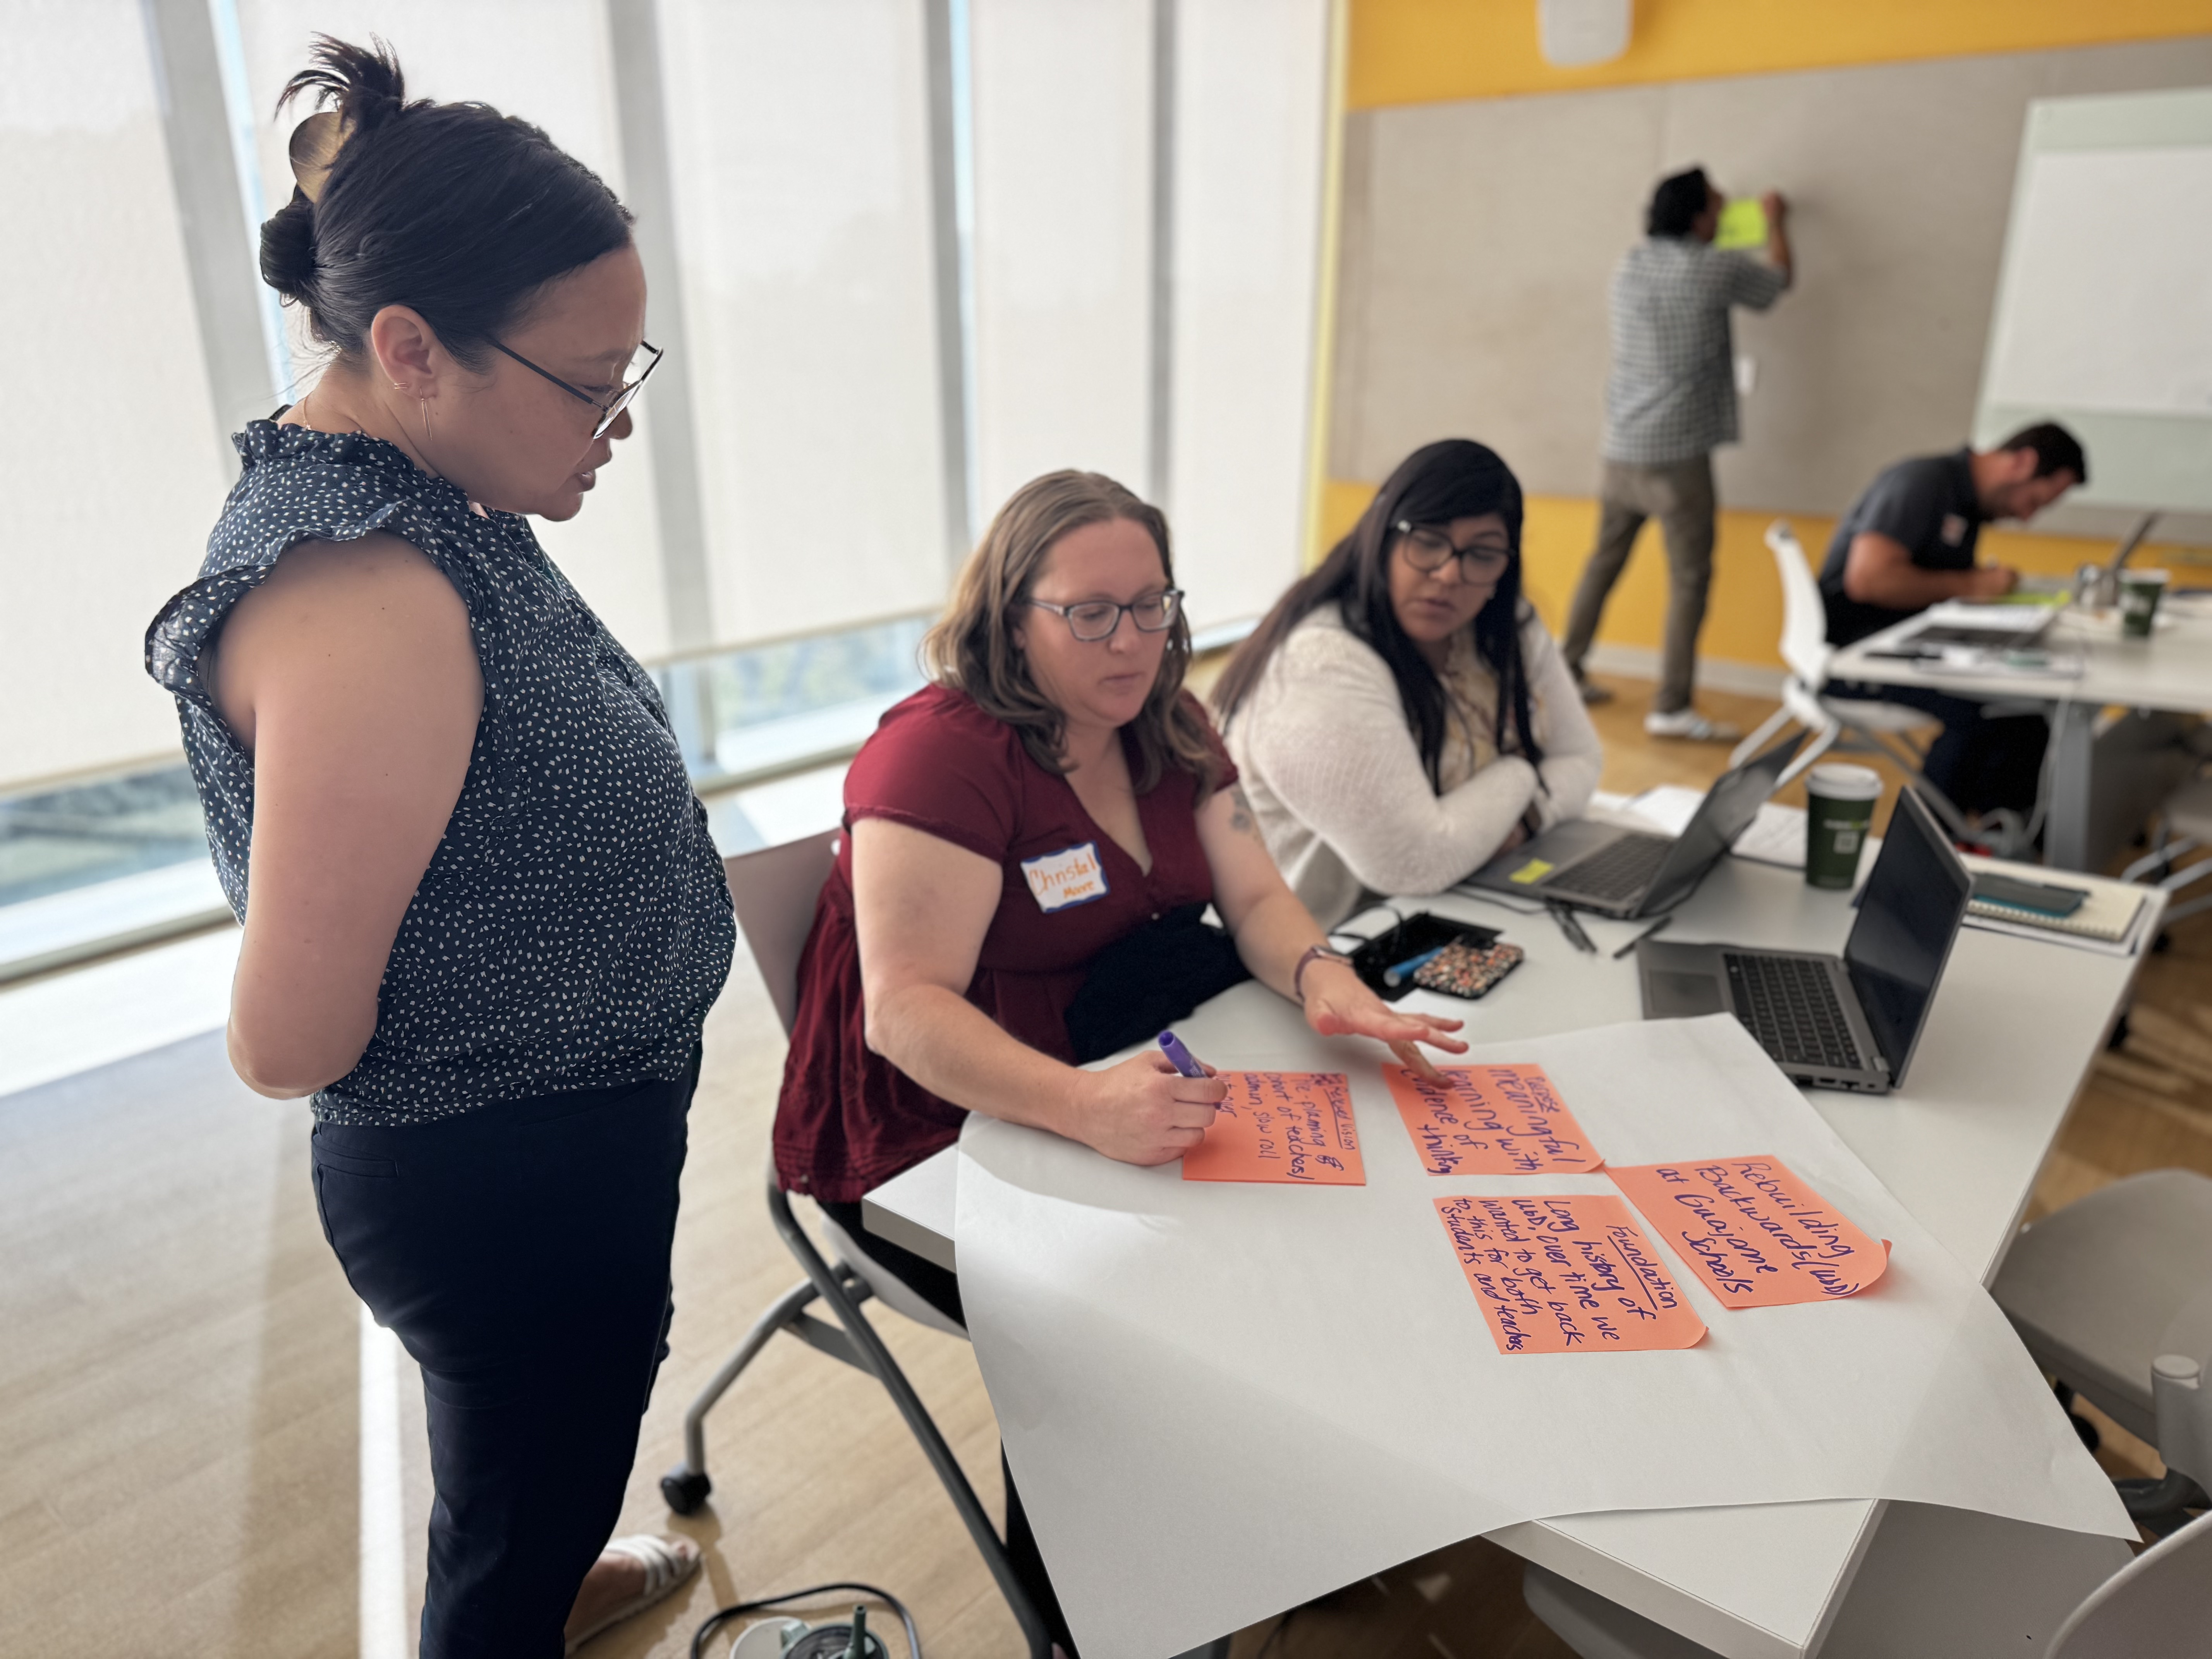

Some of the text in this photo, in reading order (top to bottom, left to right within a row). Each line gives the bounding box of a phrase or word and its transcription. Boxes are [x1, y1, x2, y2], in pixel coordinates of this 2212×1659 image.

[1253, 1111, 1275, 1134] slow
[1262, 1072, 1294, 1103] cohort
[1277, 1106, 1302, 1122] of
[1440, 1069, 1544, 1171] learning with
[1487, 1069, 1586, 1163] meaningful
[1257, 1139, 1281, 1159] roll
[1453, 1134, 1489, 1150] of
[1656, 1168, 1779, 1274] at Guajome
[1730, 1162, 1855, 1259] Rebuilding
[1452, 1197, 1543, 1316] to this for both
[1474, 1273, 1510, 1302] and
[1477, 1200, 1585, 1347] wanted to get back
[1537, 1235, 1572, 1268] over
[1558, 1271, 1600, 1311] time
[1591, 1316, 1621, 1341] we
[1543, 1200, 1657, 1322] Long history of
[1605, 1225, 1678, 1310] Foundation
[1681, 1230, 1754, 1294] Schools
